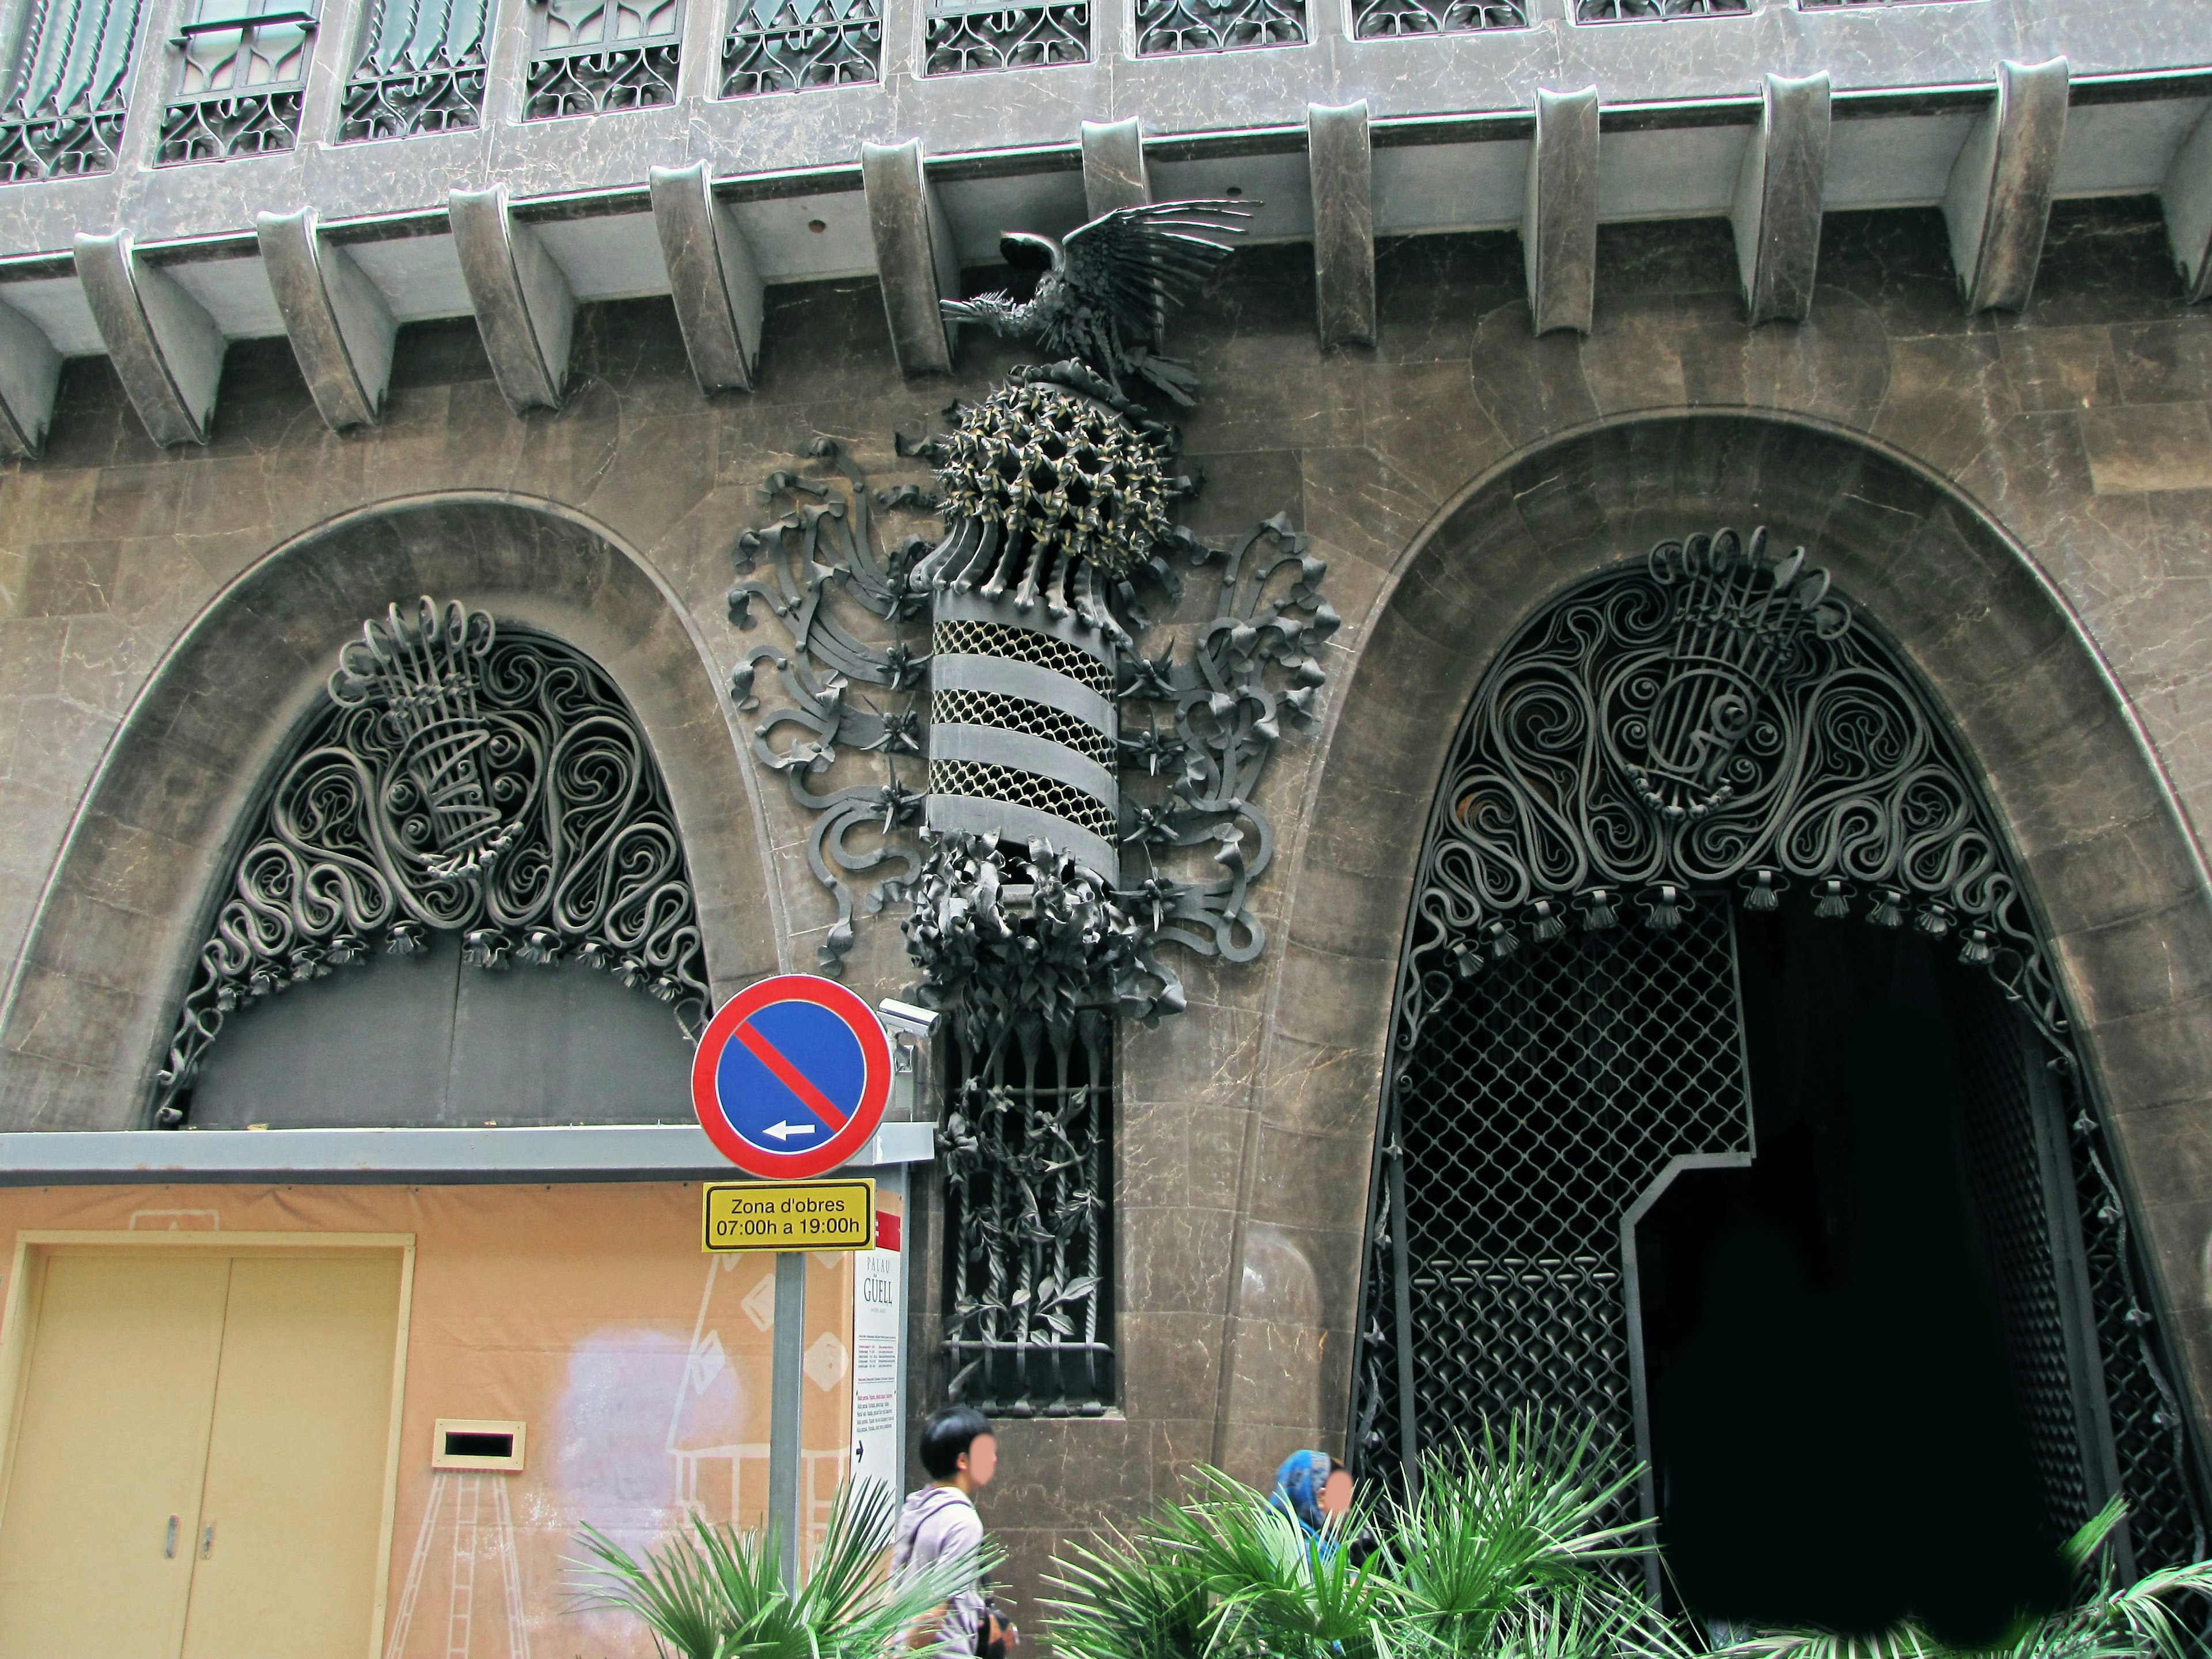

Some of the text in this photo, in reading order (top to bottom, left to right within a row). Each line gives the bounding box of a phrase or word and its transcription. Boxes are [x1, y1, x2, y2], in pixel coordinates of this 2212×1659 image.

[732, 1198, 845, 1214] Zona d'obres
[717, 1218, 860, 1236] 07:00h a 19:00h
[867, 1256, 890, 1273] PALAU
[863, 1274, 892, 1304] GÜELL
